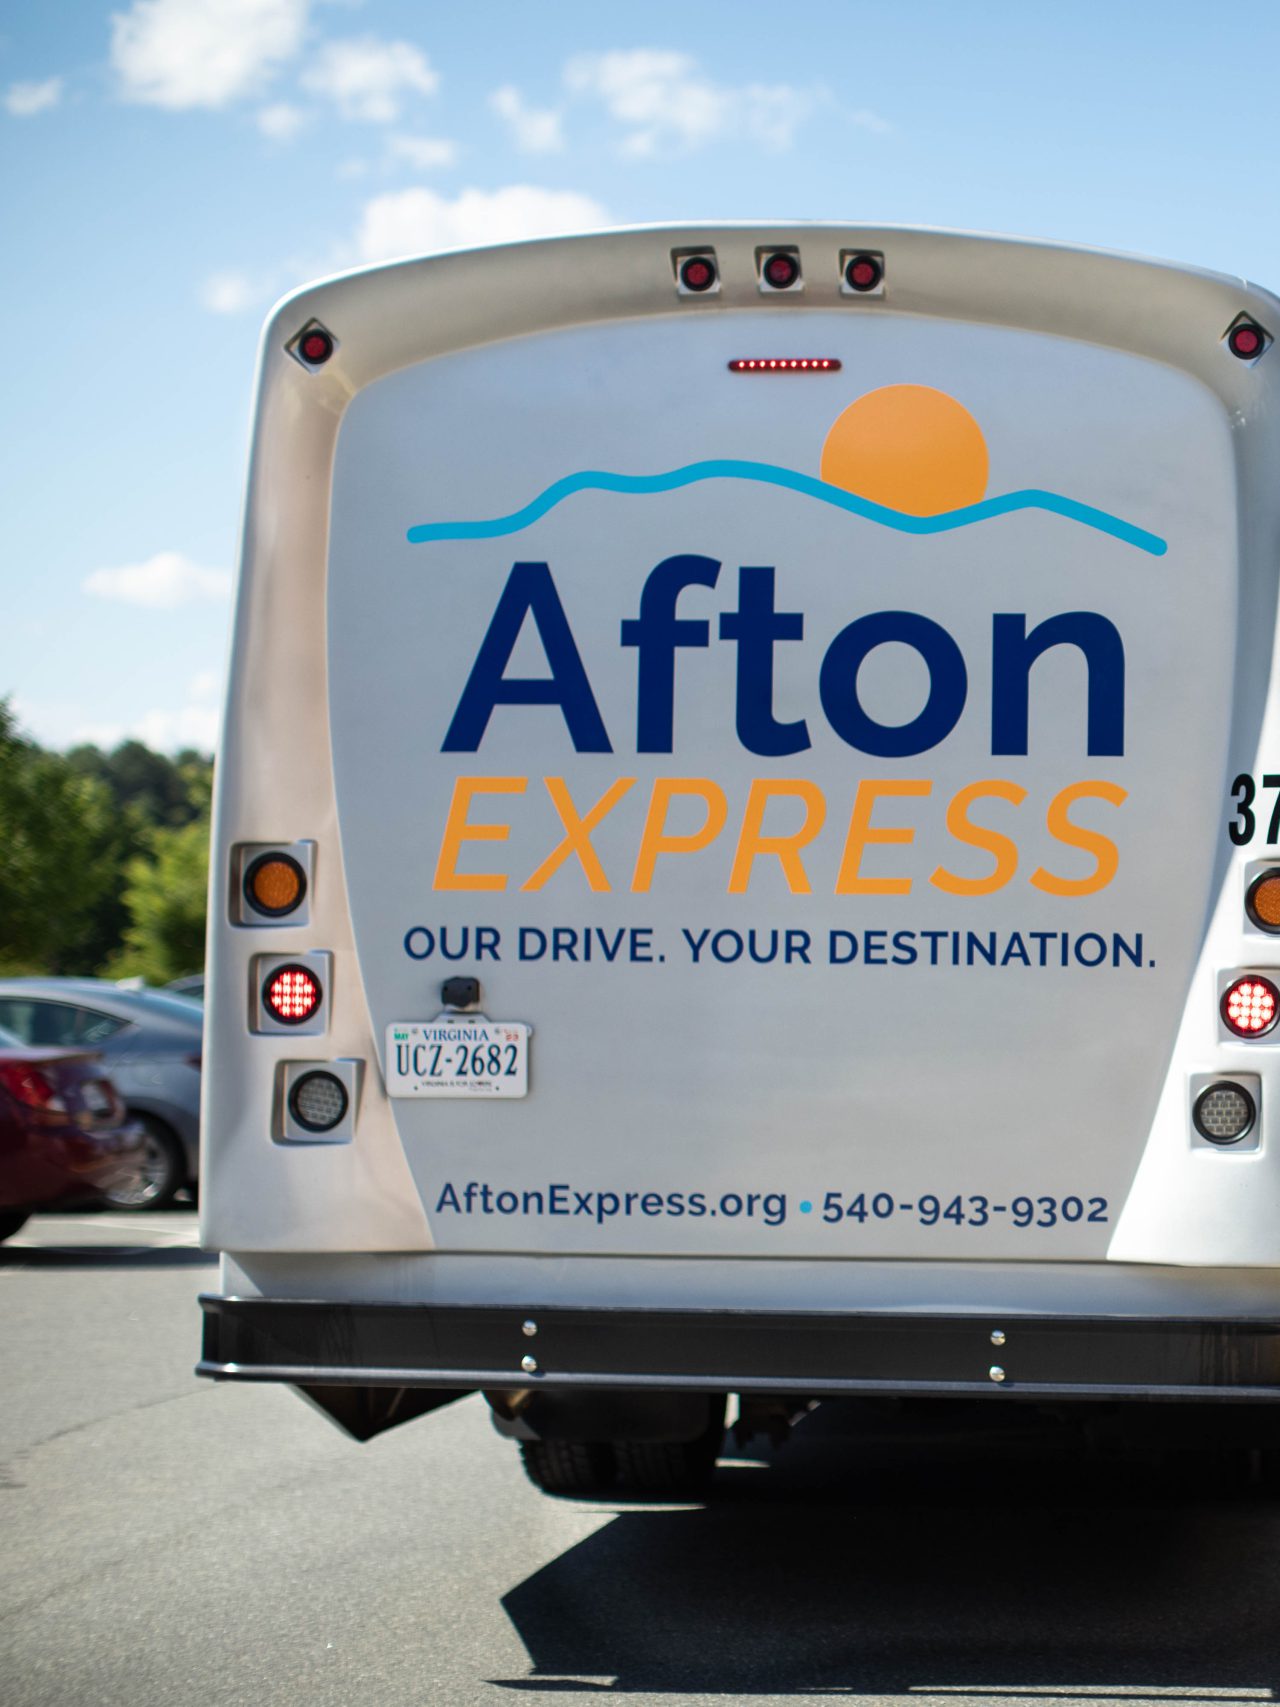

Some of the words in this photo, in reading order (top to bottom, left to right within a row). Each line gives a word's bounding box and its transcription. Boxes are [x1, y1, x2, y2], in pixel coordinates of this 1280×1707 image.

[440, 553, 1126, 758] Afton
[432, 776, 1129, 897] EXPRESS
[404, 926, 502, 961] OUR
[518, 927, 666, 963] DRIVE.
[682, 928, 812, 964] YOUR
[829, 930, 1156, 967] DESTINATION.
[423, 1029, 489, 1041] VIRGINIA
[396, 1044, 518, 1076] UCZ-2682
[436, 1182, 787, 1226] AftonExpress.org
[822, 1192, 1109, 1228] 540-943-9302
